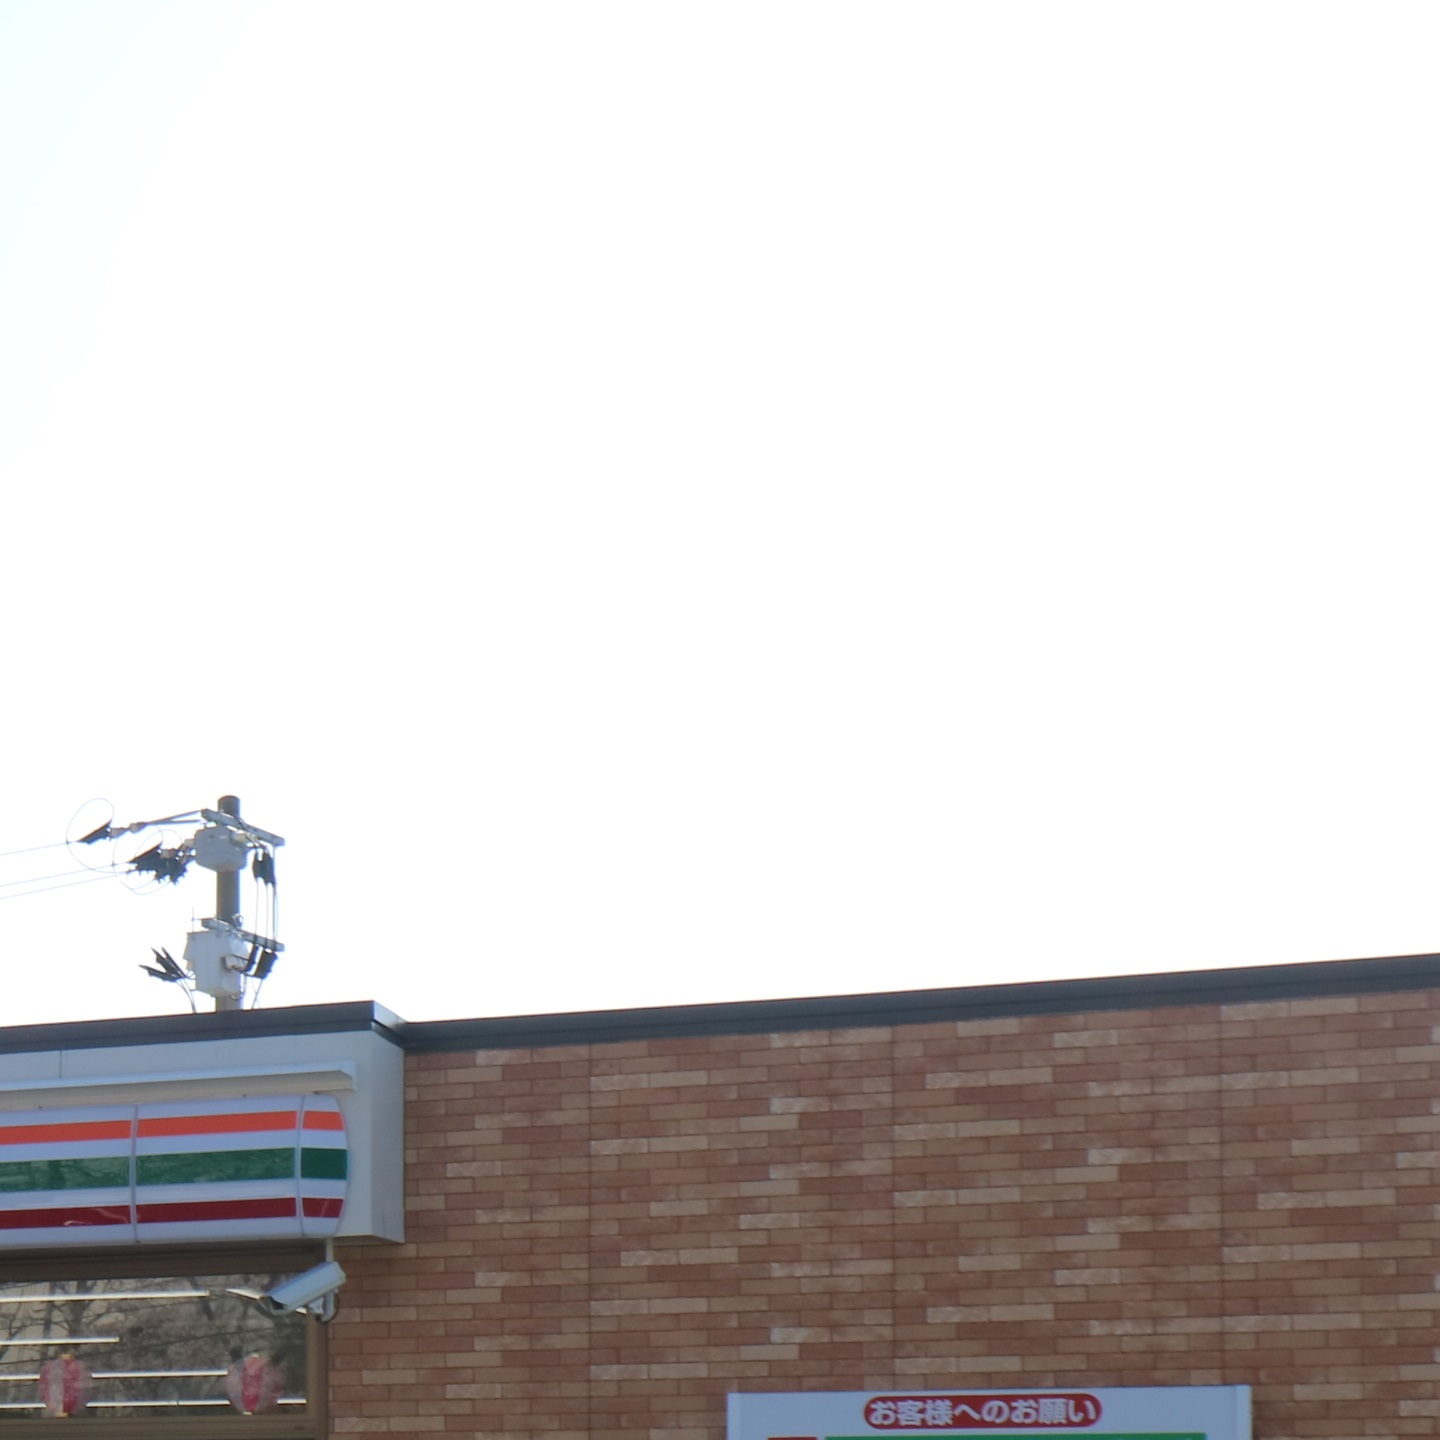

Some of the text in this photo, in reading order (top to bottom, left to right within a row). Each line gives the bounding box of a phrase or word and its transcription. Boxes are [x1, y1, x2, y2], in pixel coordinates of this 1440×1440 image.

[869, 1398, 1099, 1427] お客様へのお願い
